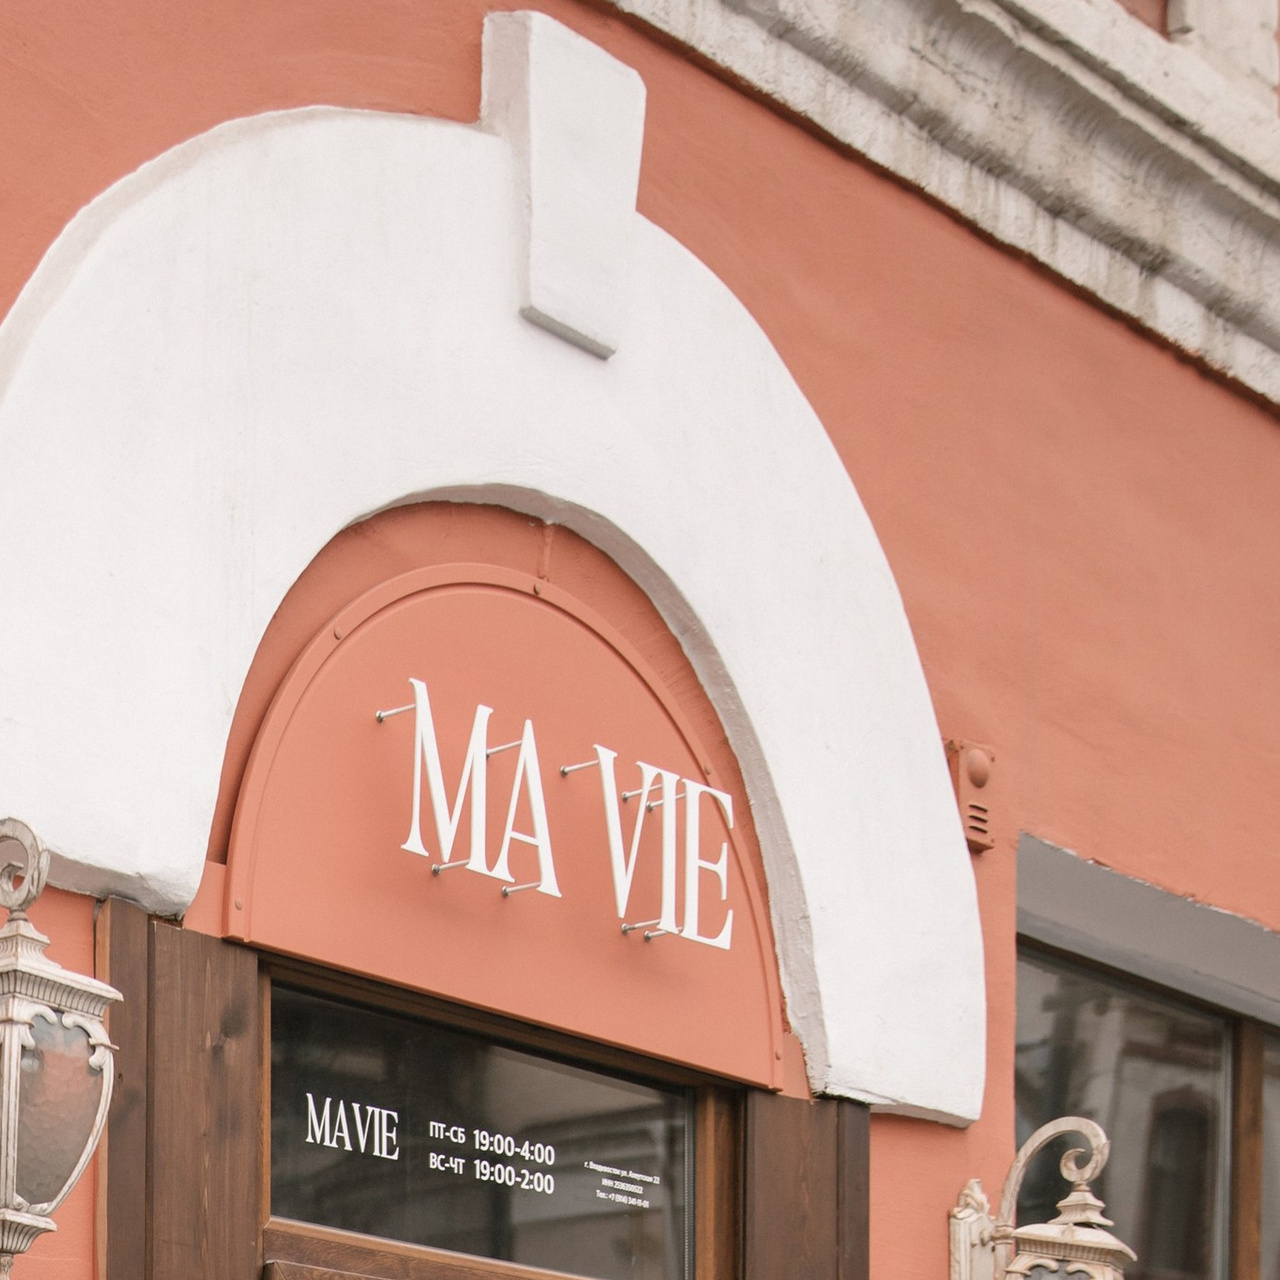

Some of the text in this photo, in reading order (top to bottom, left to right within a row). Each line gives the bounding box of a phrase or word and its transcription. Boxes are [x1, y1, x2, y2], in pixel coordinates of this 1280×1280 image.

[400, 677, 734, 950] MA VIE
[429, 1121, 555, 1165] ПТ-СБ 19:00-4:00
[429, 1152, 554, 1194] ВС-ЧТ 19:00-2:00
